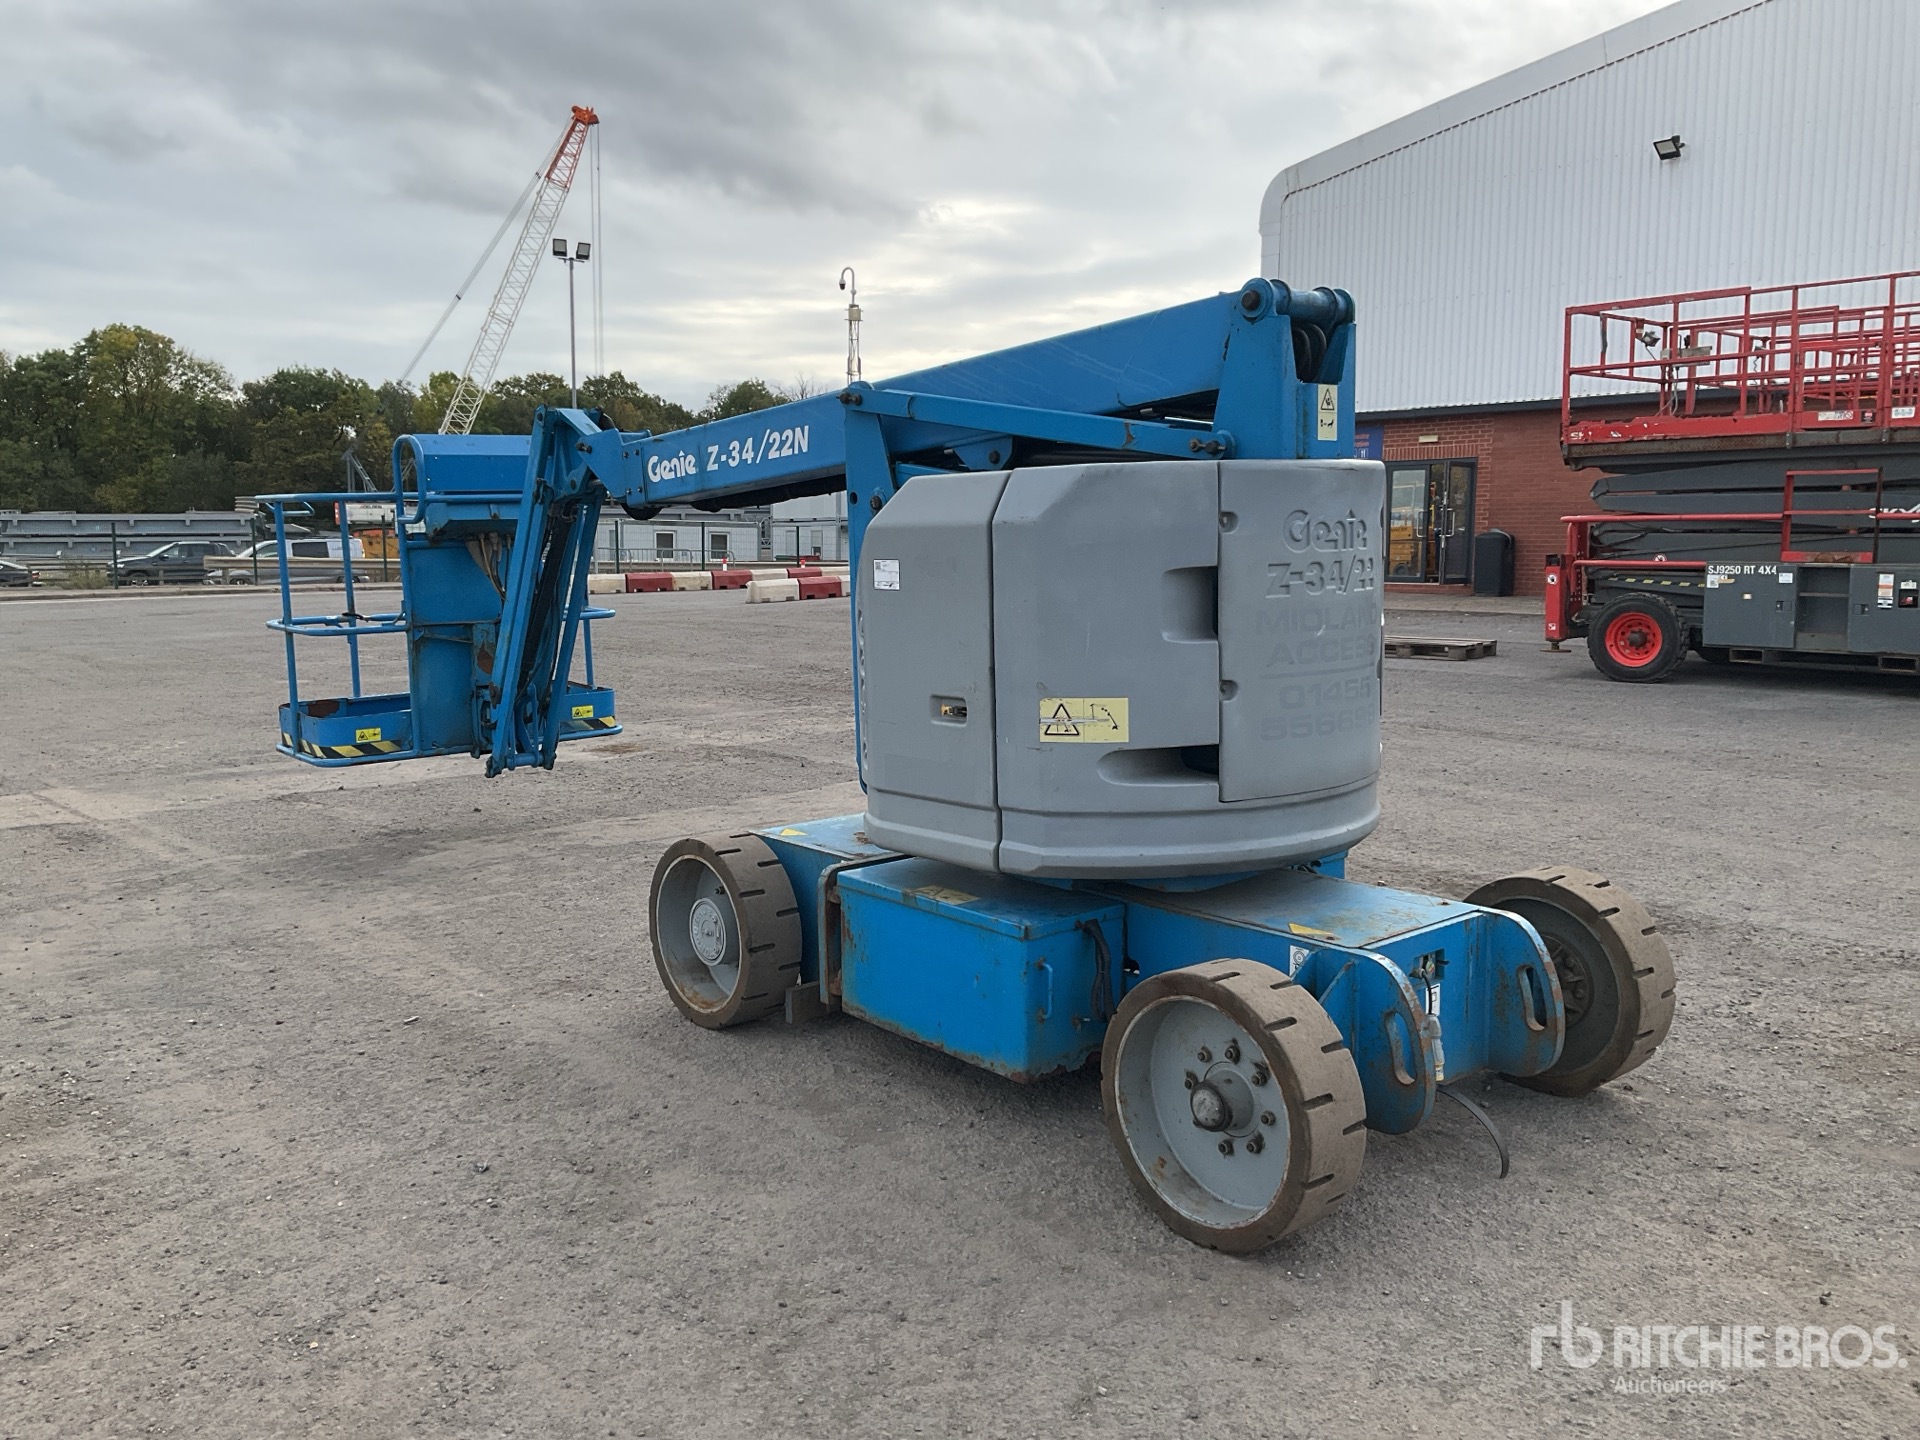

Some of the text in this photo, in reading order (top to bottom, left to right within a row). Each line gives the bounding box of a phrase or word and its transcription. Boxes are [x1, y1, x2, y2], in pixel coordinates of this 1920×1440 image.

[648, 425, 810, 483] Genie Z-34/22N
[1282, 508, 1368, 553] Genie
[1708, 565, 1778, 576] SJ9250 RT 4X4
